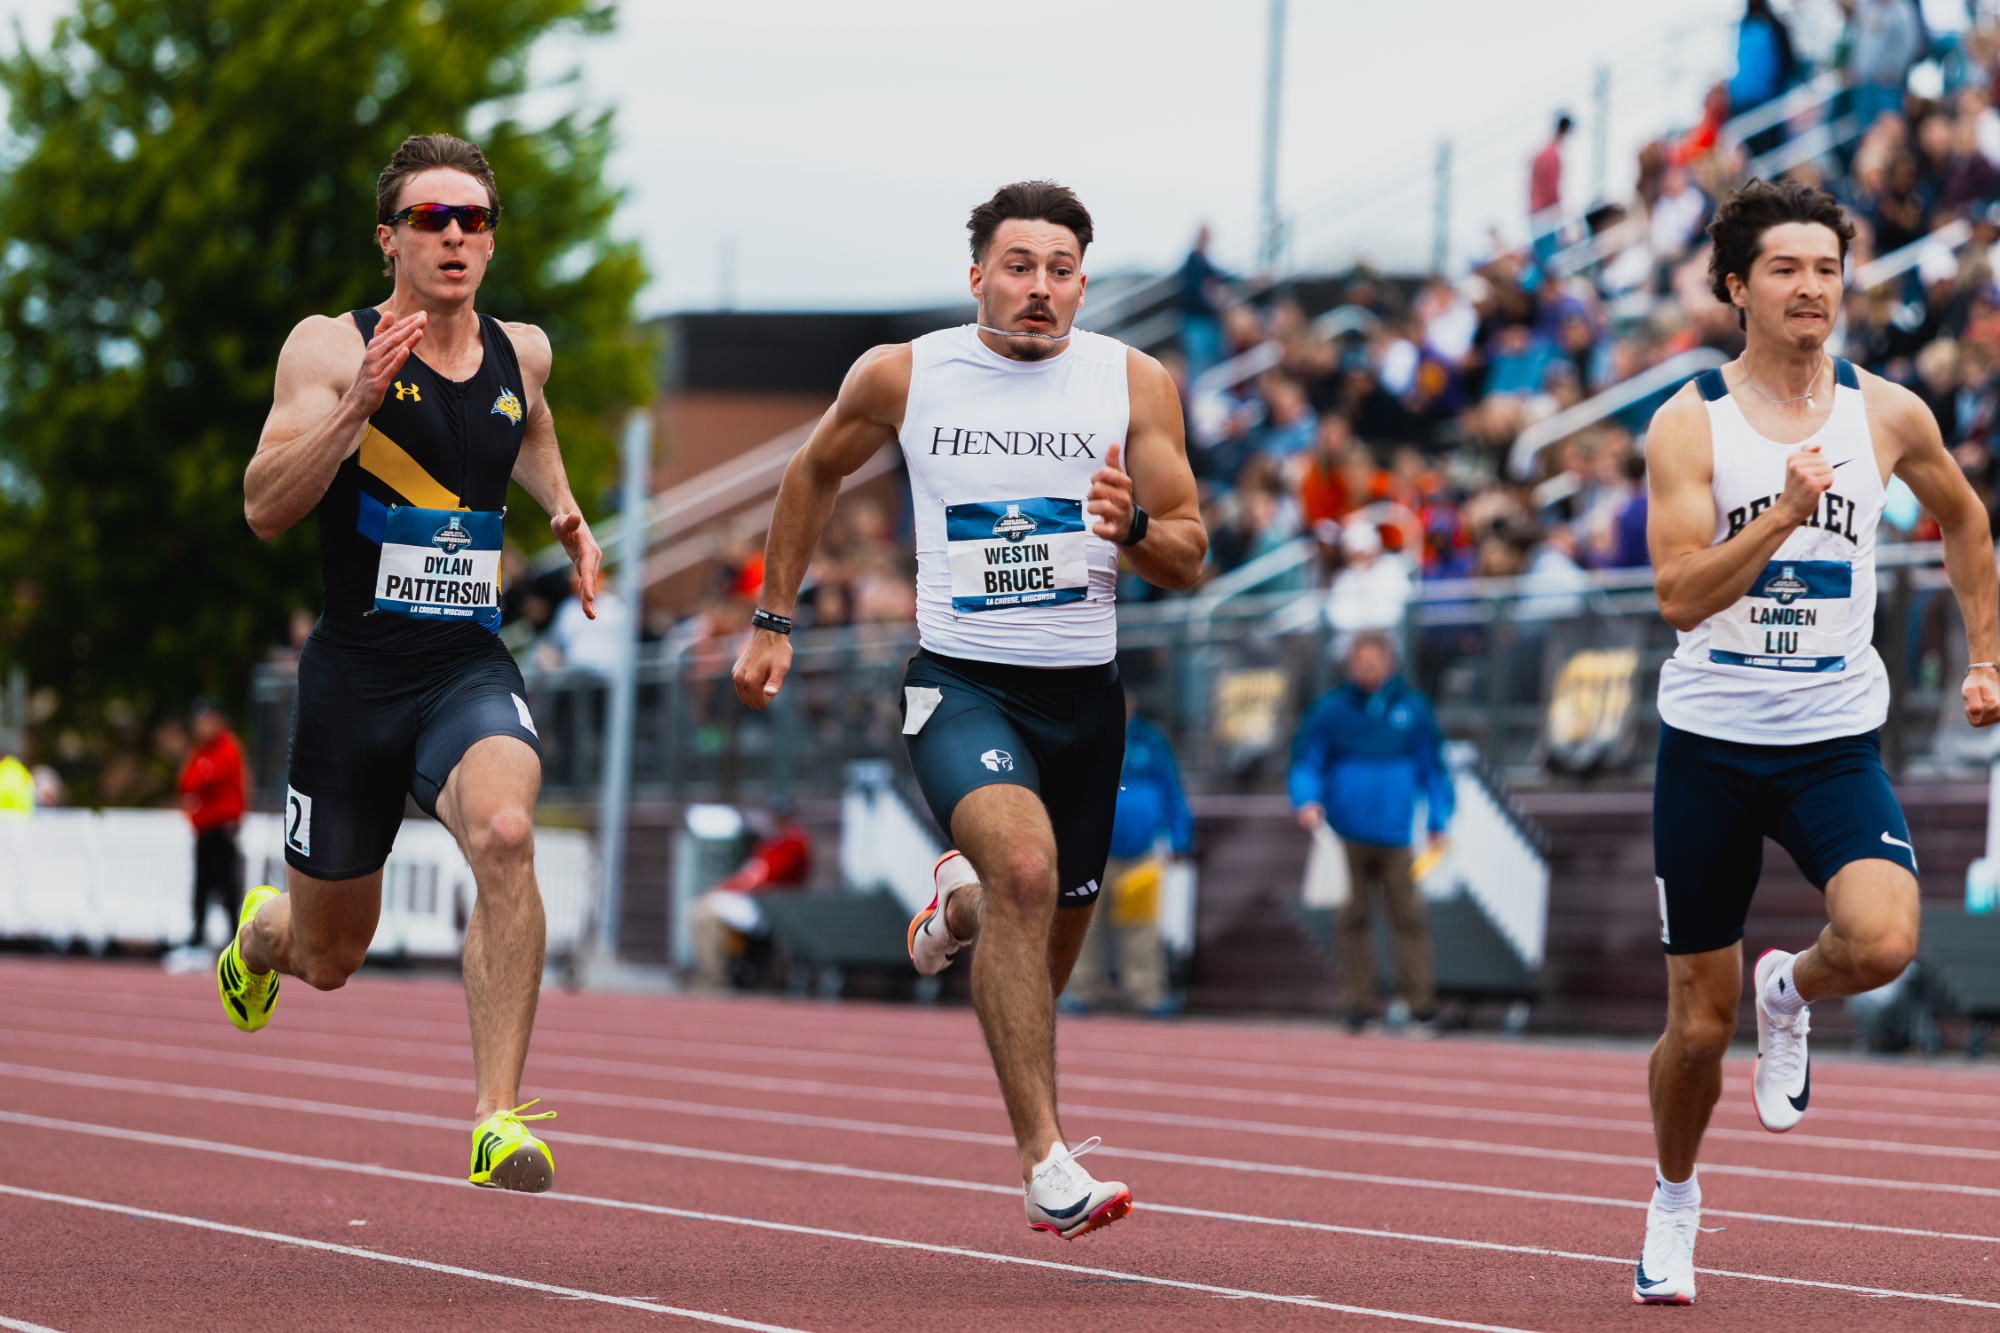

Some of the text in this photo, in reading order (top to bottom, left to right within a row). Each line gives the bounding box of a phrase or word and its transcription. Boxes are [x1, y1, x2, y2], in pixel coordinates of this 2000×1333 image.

[928, 426, 1097, 461] HENDRIX
[1725, 491, 1857, 546] BEEL
[984, 543, 1049, 565] WESTIN
[424, 556, 473, 576] DYLAN
[385, 575, 490, 605] PATTERSON
[984, 566, 1055, 593] BRUCE
[986, 598, 994, 606] LA
[1021, 592, 1056, 603] WISCONSIN
[410, 605, 418, 613] LA
[443, 608, 474, 617] WISCONSIN
[1750, 606, 1817, 626] LANDEN
[1765, 631, 1798, 654] LIU
[289, 795, 302, 851] 2
